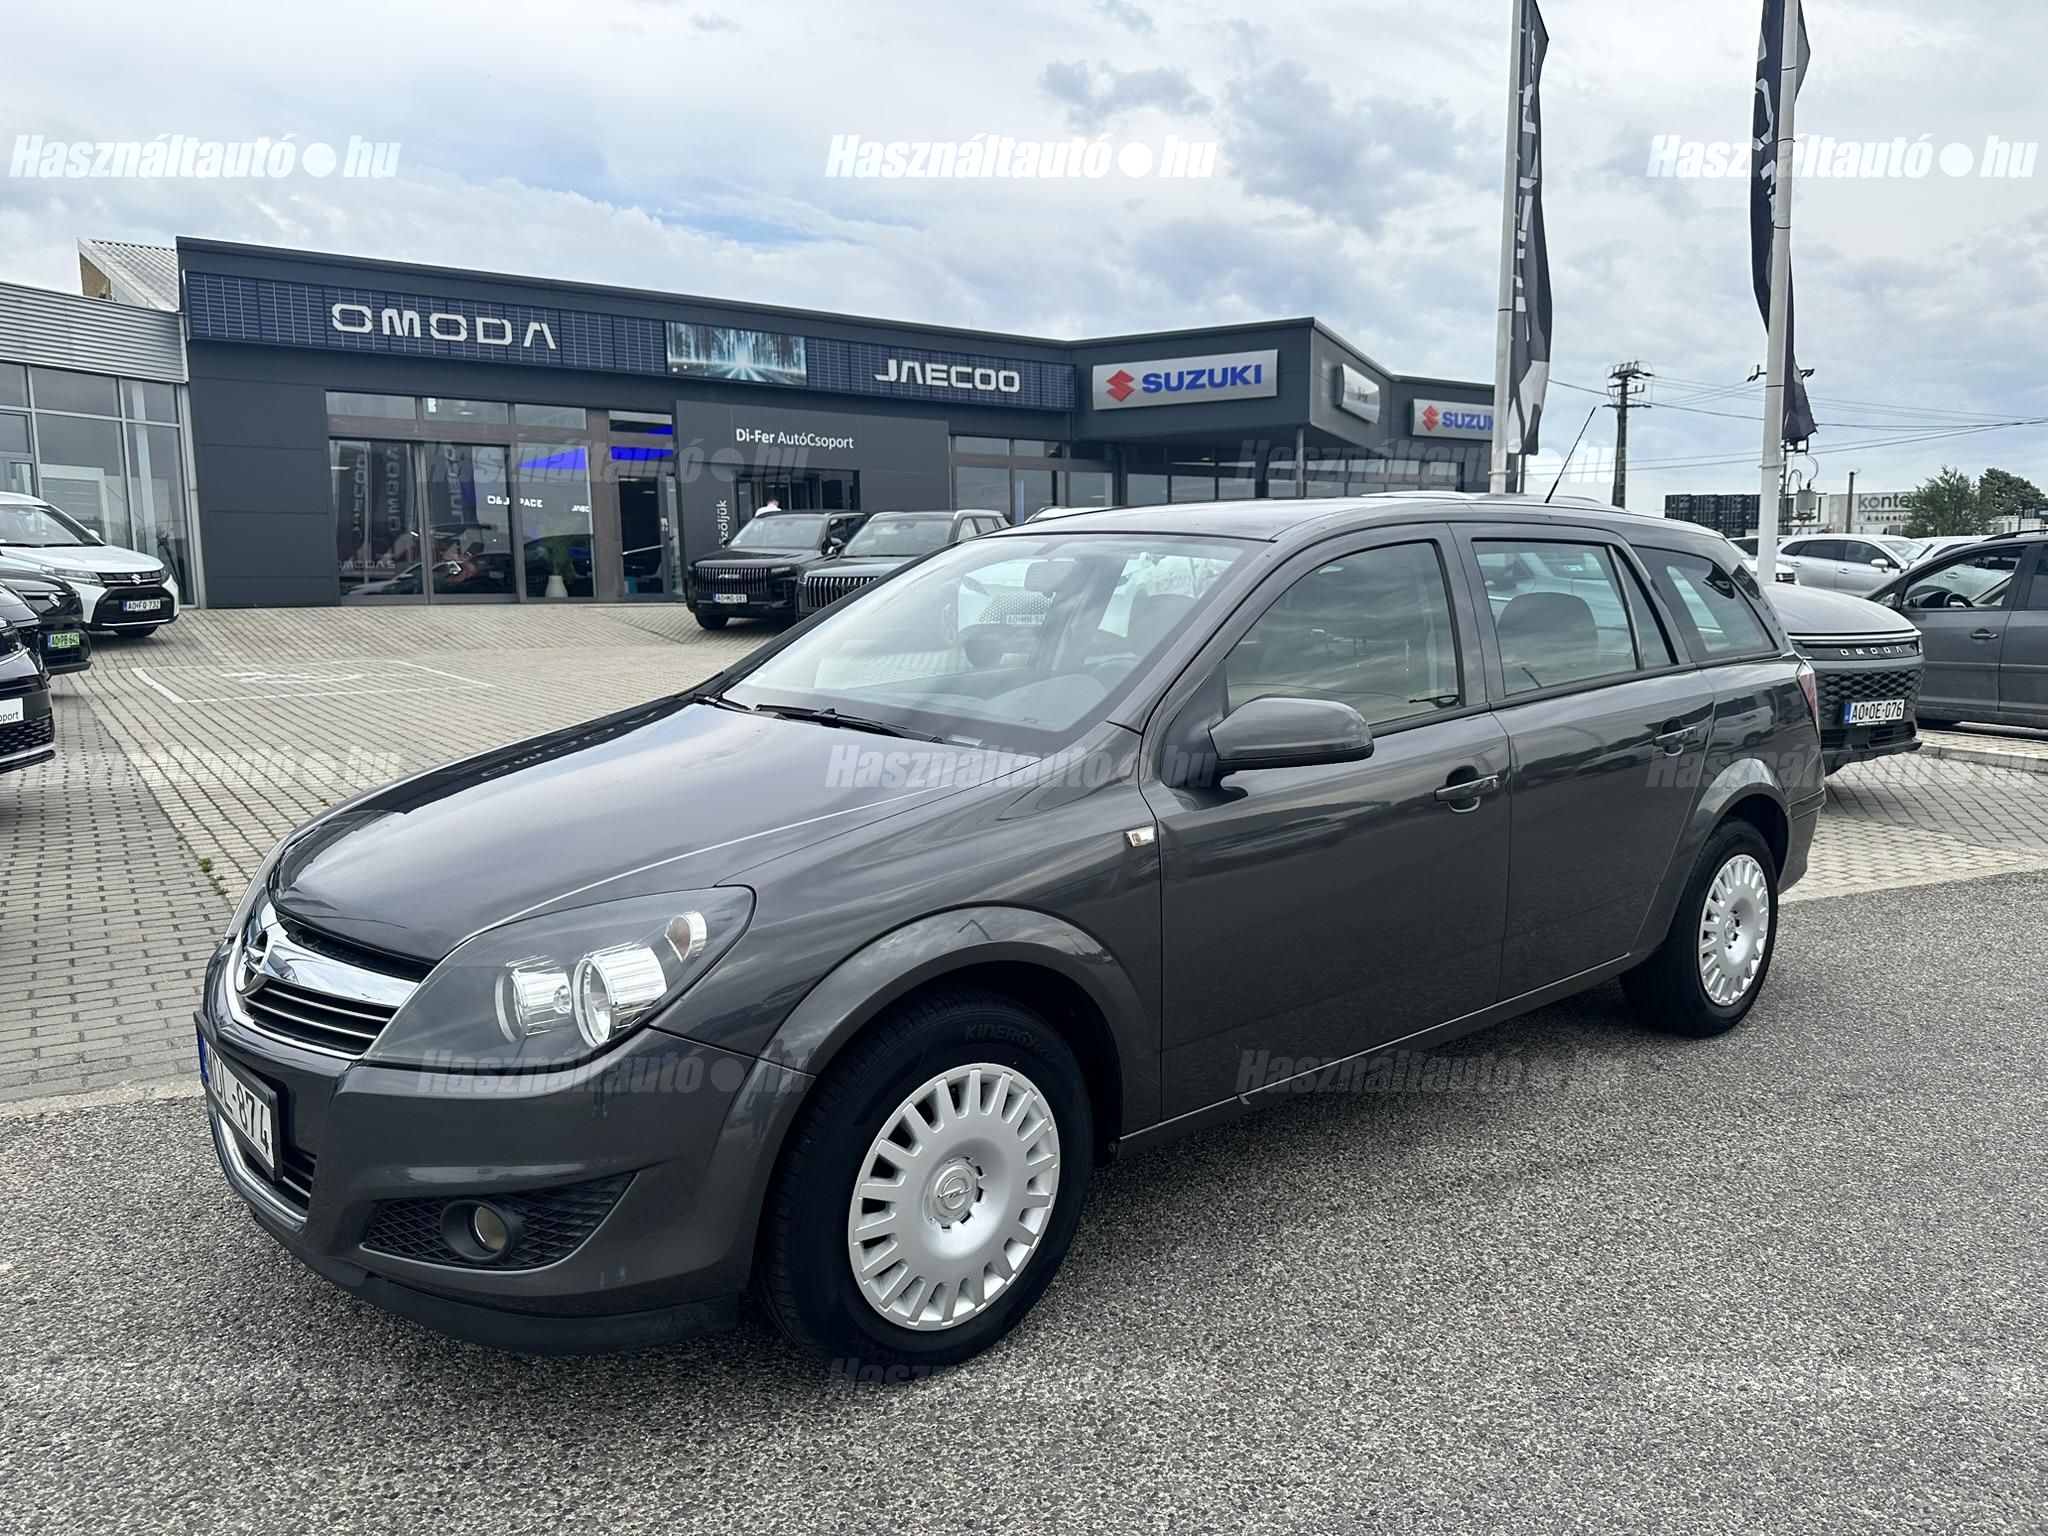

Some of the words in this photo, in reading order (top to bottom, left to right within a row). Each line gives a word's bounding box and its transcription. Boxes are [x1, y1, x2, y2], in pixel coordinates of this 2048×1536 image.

[332, 303, 557, 349] OMODA
[874, 359, 1020, 393] JAECOO
[1142, 364, 1262, 393] SUZUKI
[736, 428, 775, 443] Di-Fer
[777, 431, 854, 450] AutóCsoport
[1840, 646, 1902, 656] OMODA
